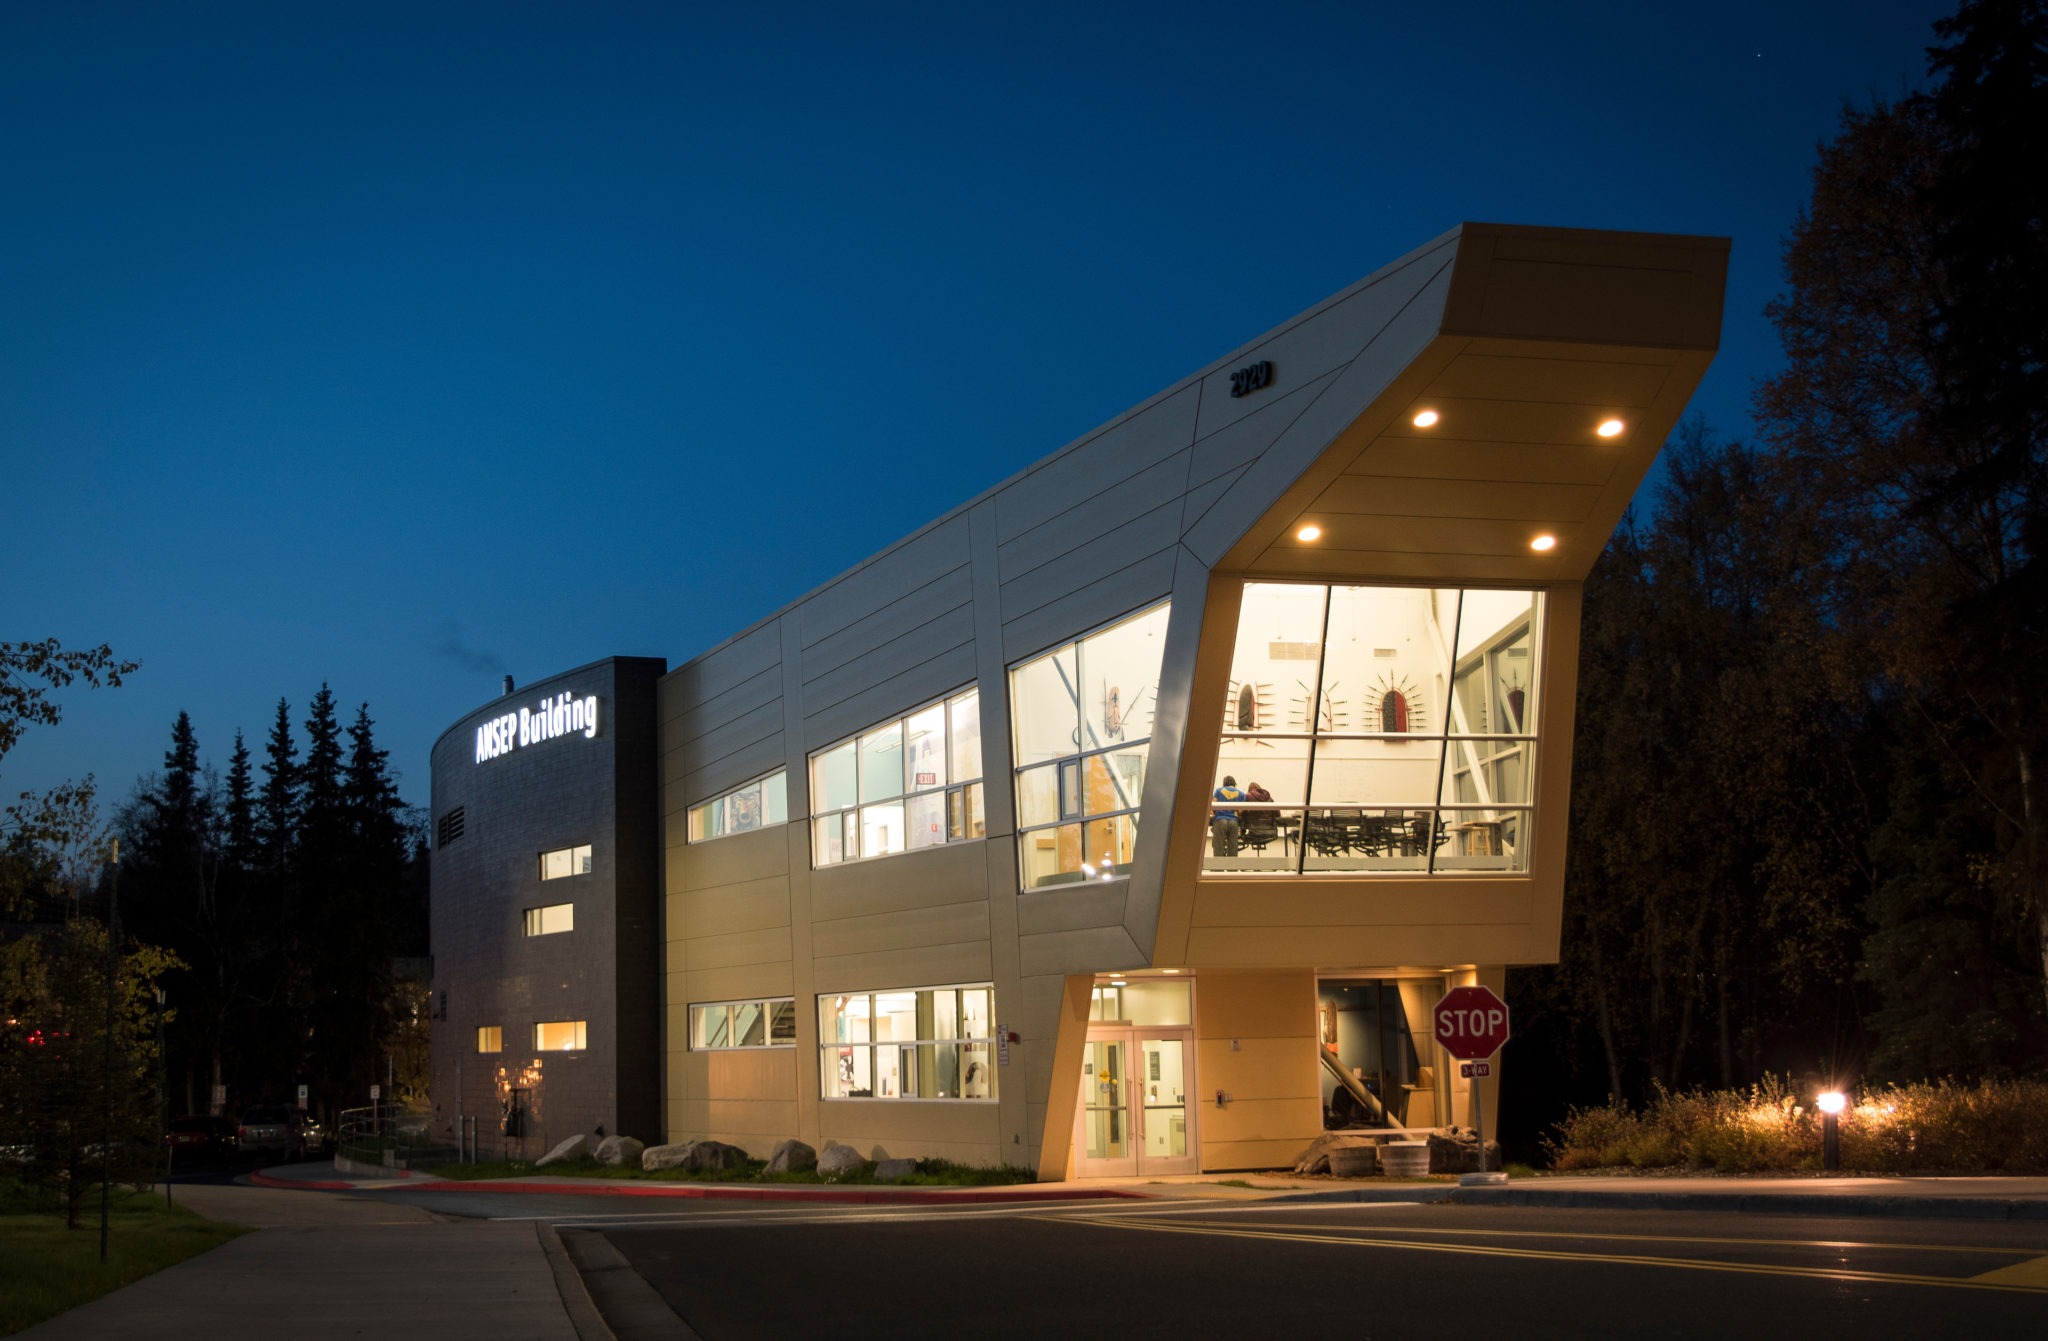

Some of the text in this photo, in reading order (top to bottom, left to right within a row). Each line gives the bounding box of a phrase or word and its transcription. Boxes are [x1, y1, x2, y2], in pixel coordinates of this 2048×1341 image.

[1230, 361, 1271, 398] 2929
[475, 690, 597, 765] ANSEP Building
[919, 773, 935, 784] EXIT
[1439, 1009, 1503, 1037] STOP
